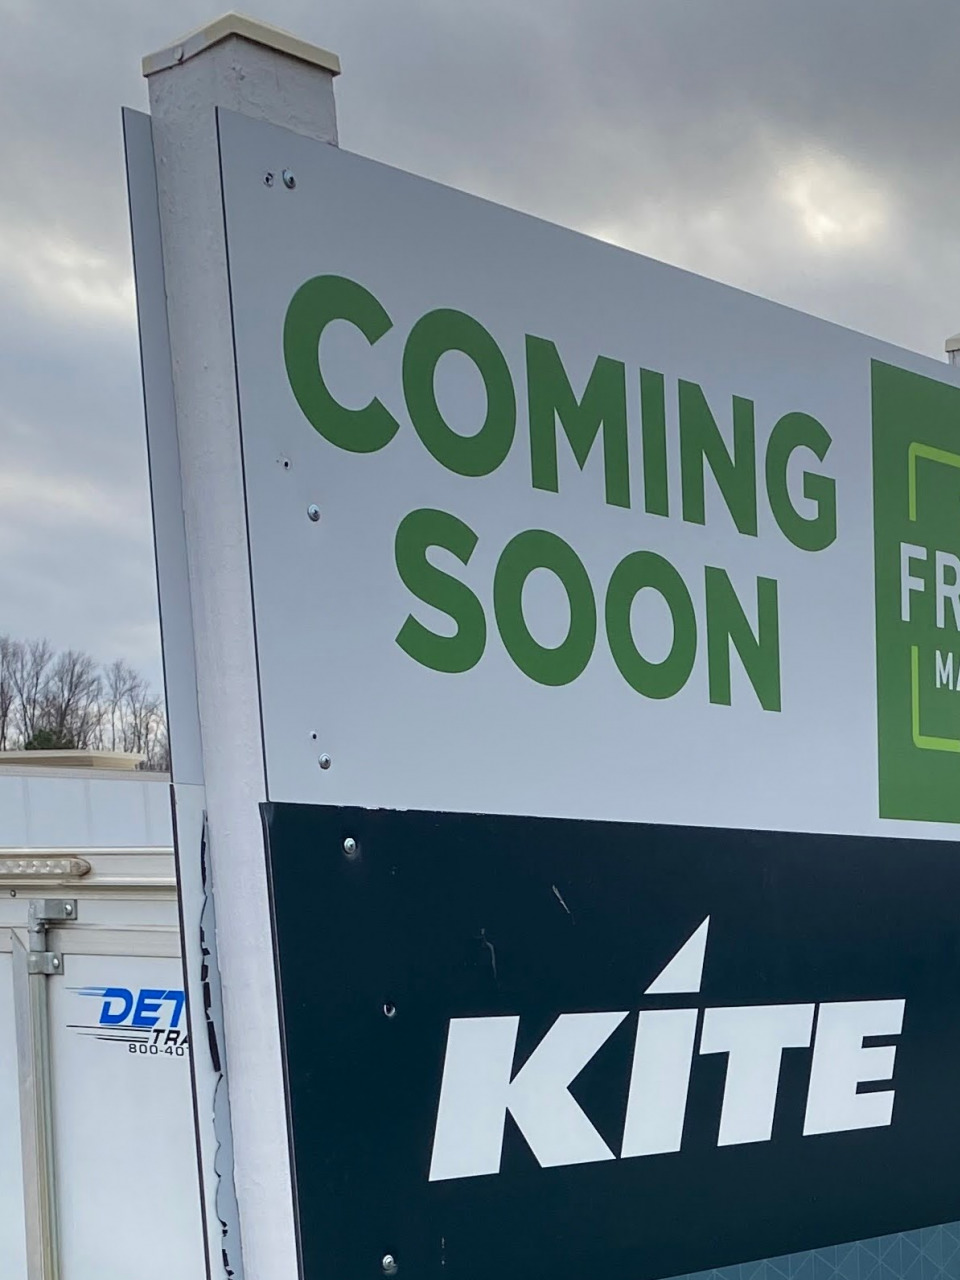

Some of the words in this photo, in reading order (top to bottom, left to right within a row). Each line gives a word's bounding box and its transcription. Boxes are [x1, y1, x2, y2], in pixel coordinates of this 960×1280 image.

[283, 274, 837, 552] COMING
[394, 507, 782, 713] SOON
[428, 914, 906, 1182] KITE
